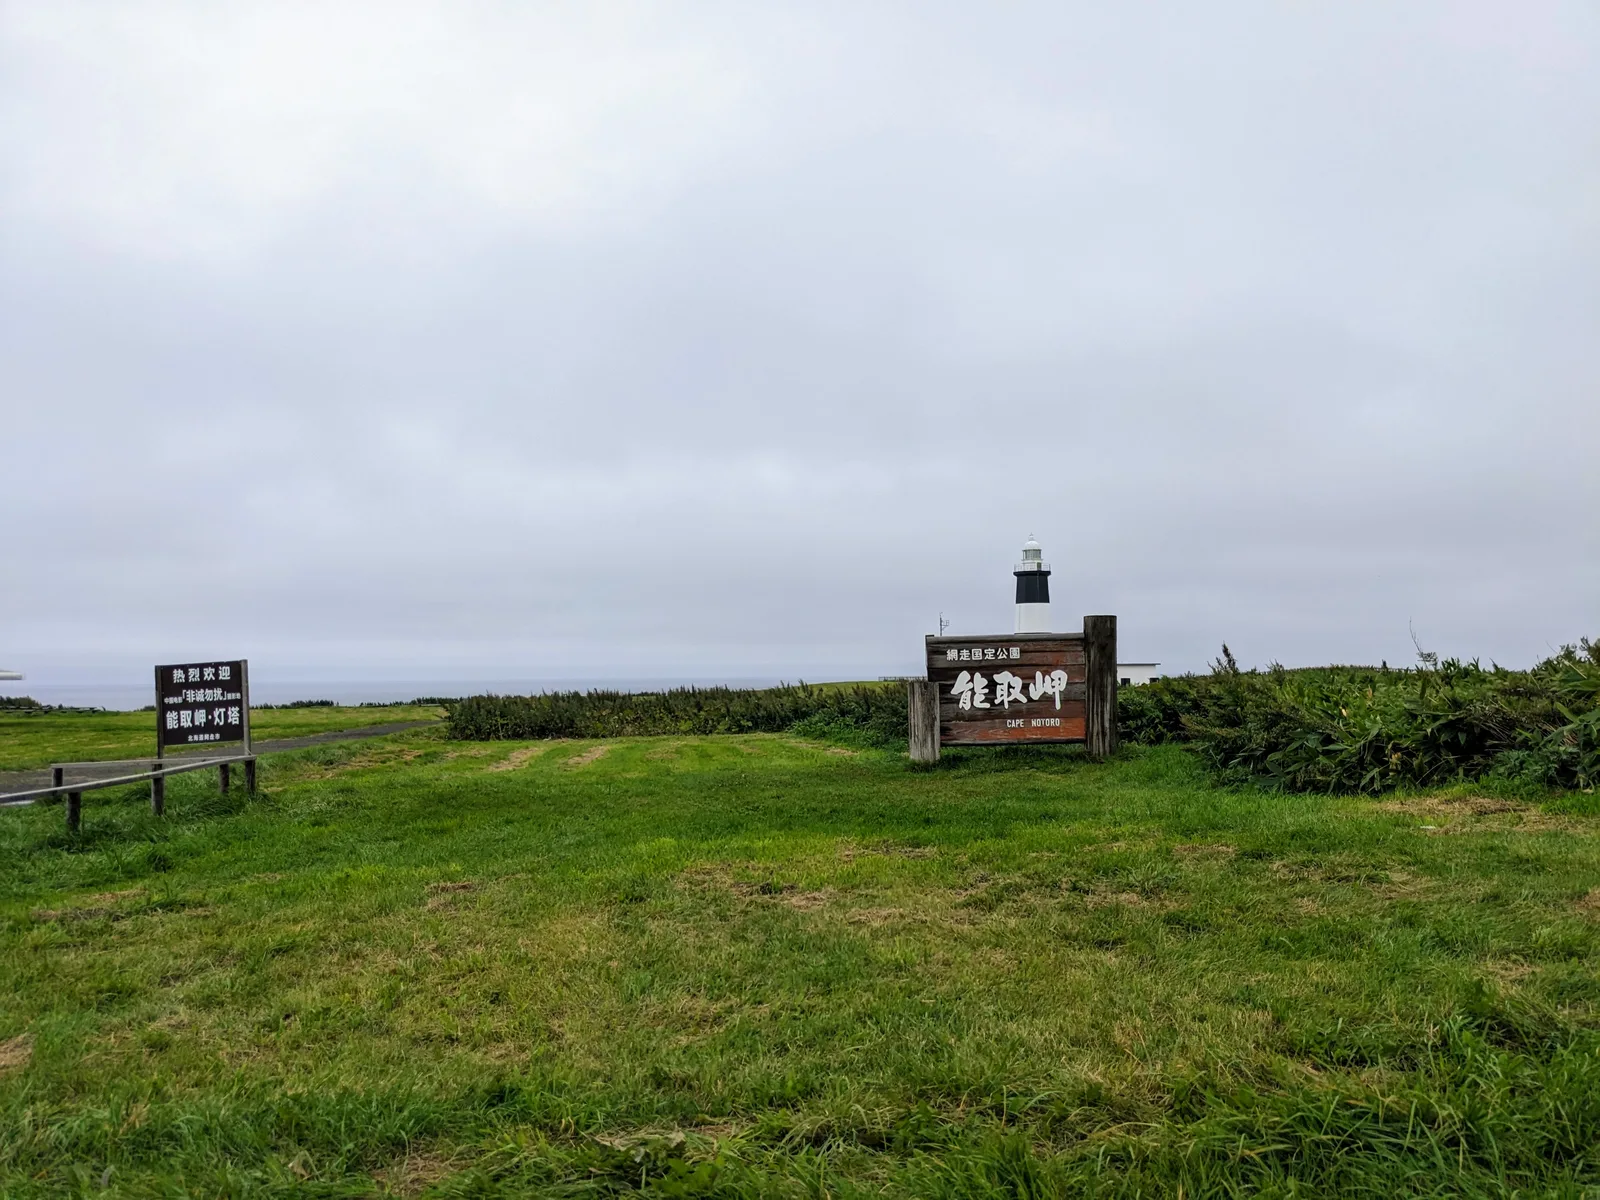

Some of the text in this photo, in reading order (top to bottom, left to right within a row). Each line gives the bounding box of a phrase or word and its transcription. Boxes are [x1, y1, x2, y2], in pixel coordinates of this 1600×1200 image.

[946, 647, 1021, 661] 網走国定公園
[173, 666, 231, 683] 热烈欢迎
[950, 669, 1068, 711] 能取岬
[1006, 718, 1060, 728] CAPE NOTORO
